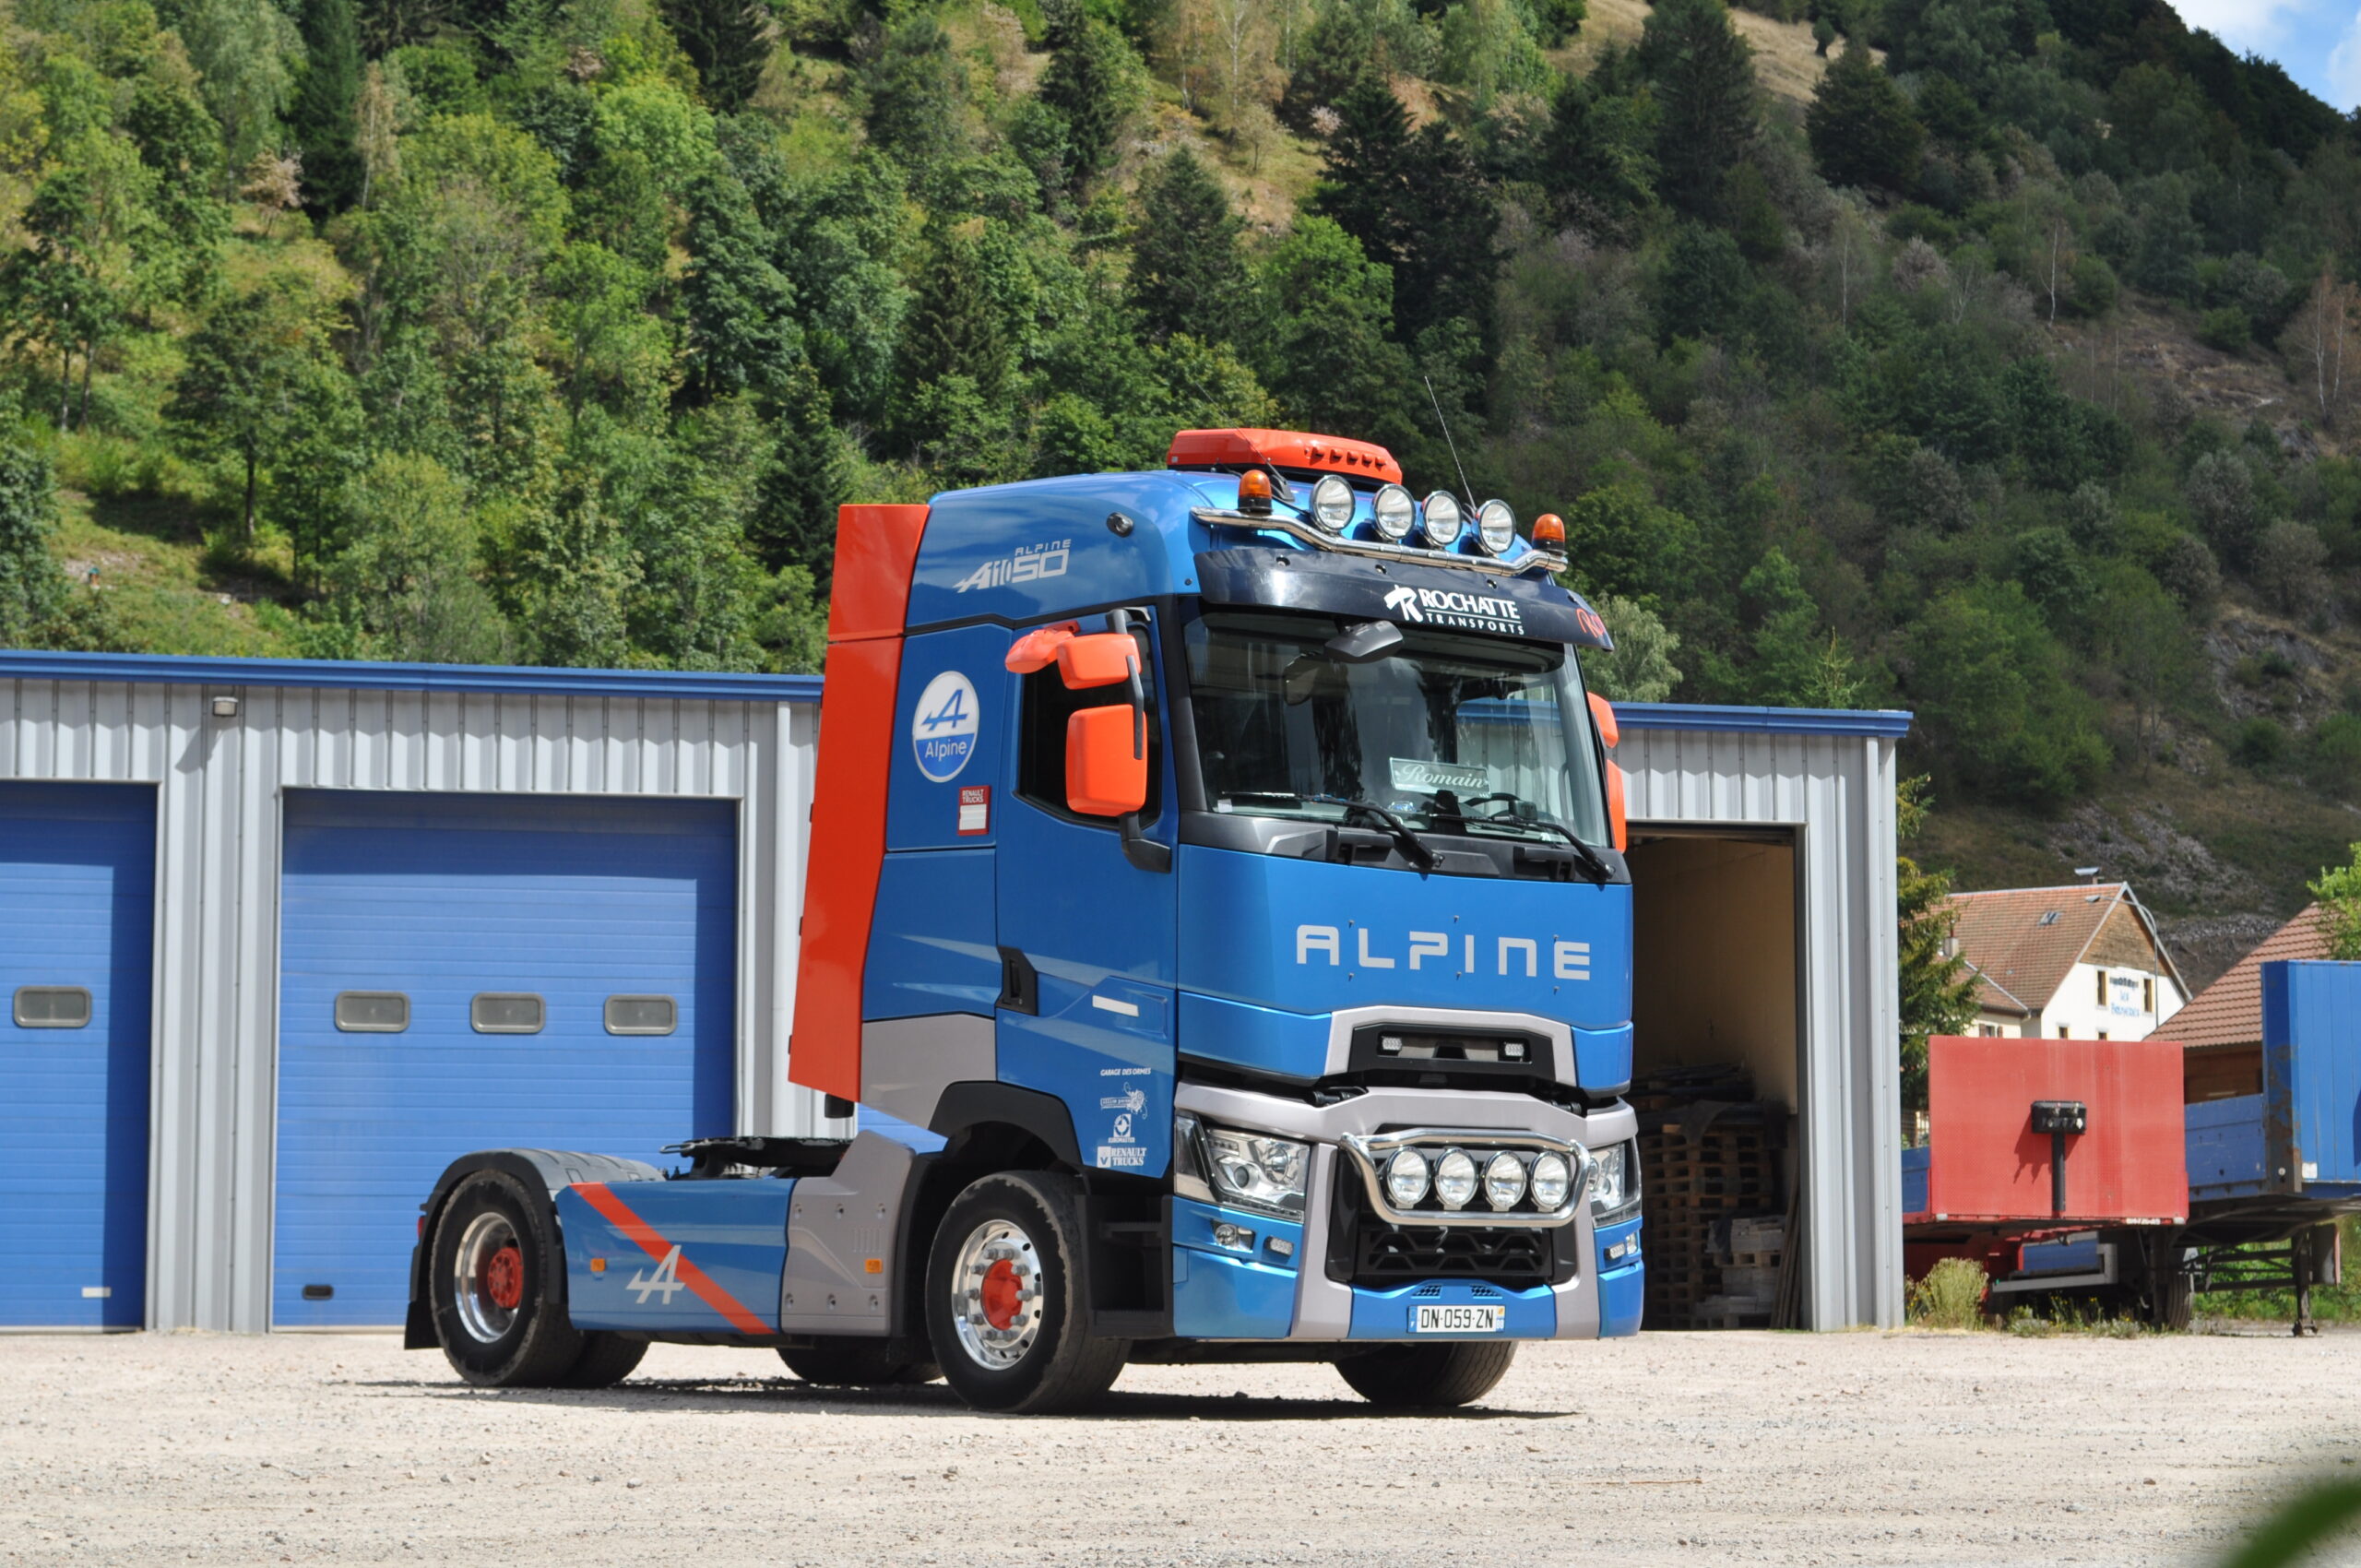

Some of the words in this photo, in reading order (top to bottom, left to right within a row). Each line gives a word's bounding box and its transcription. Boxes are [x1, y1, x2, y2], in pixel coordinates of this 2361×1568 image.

[1015, 539, 1072, 556] ALPINE
[1418, 588, 1521, 620] ROCHATTE
[1426, 612, 1525, 636] TRANSPORTS
[925, 740, 967, 763] Alpine
[1395, 764, 1485, 789] Romain
[962, 789, 984, 797] RENAULT
[962, 795, 984, 804] TRUCKS
[1297, 924, 1591, 980] ALPINE
[1111, 1147, 1147, 1158] RENAULT
[1112, 1157, 1145, 1167] TRUCKS
